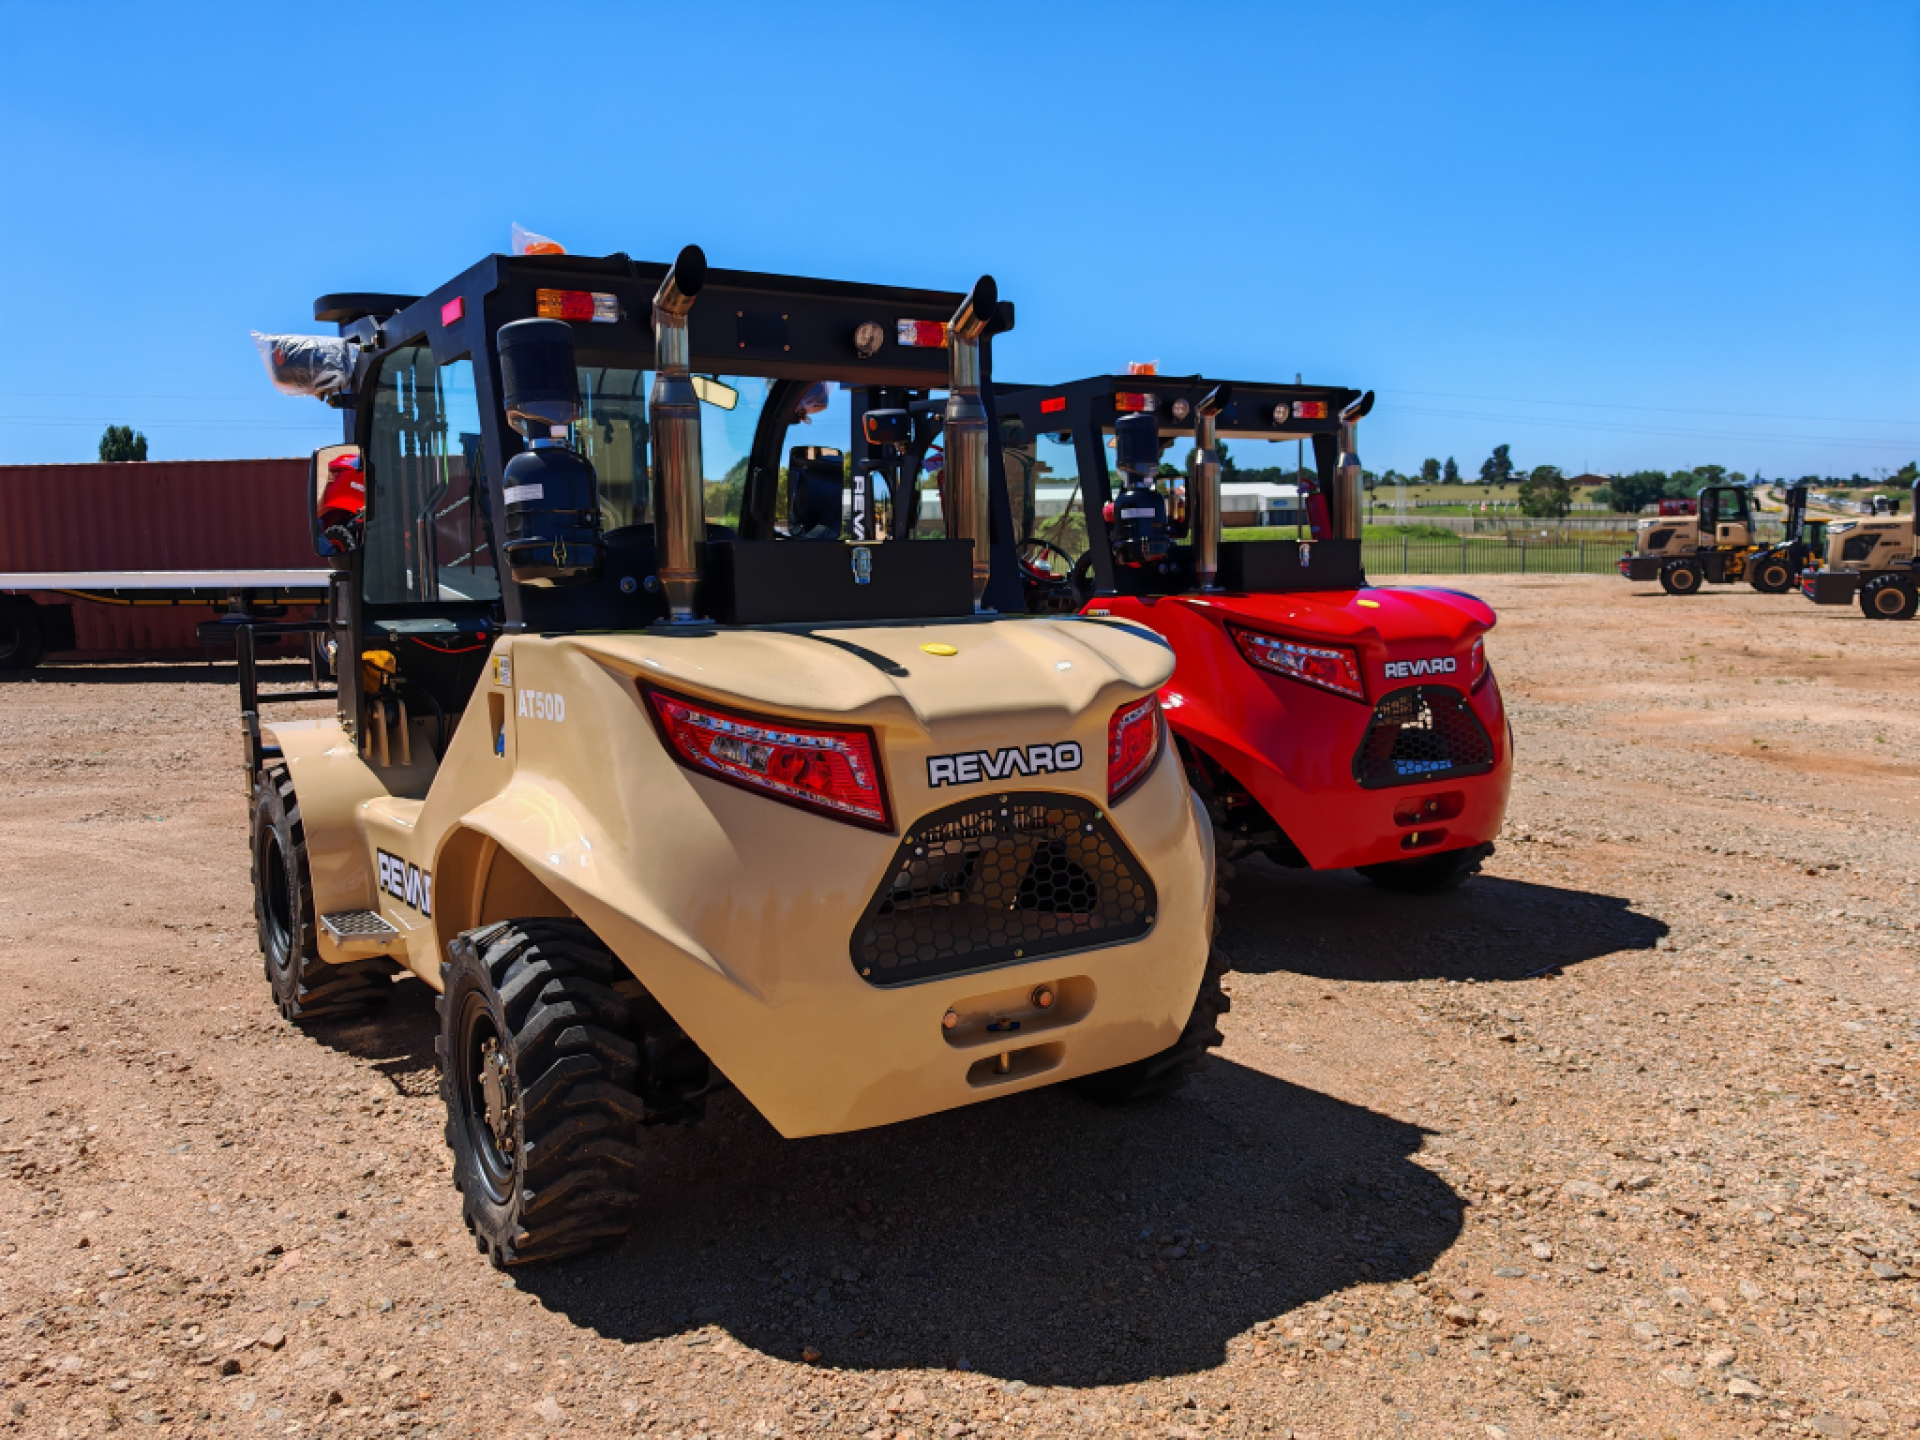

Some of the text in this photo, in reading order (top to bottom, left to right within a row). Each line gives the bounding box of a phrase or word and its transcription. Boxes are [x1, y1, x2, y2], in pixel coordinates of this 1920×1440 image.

[1384, 656, 1457, 679] REVARO
[518, 689, 565, 723] AT50D
[927, 741, 1083, 788] REVARO
